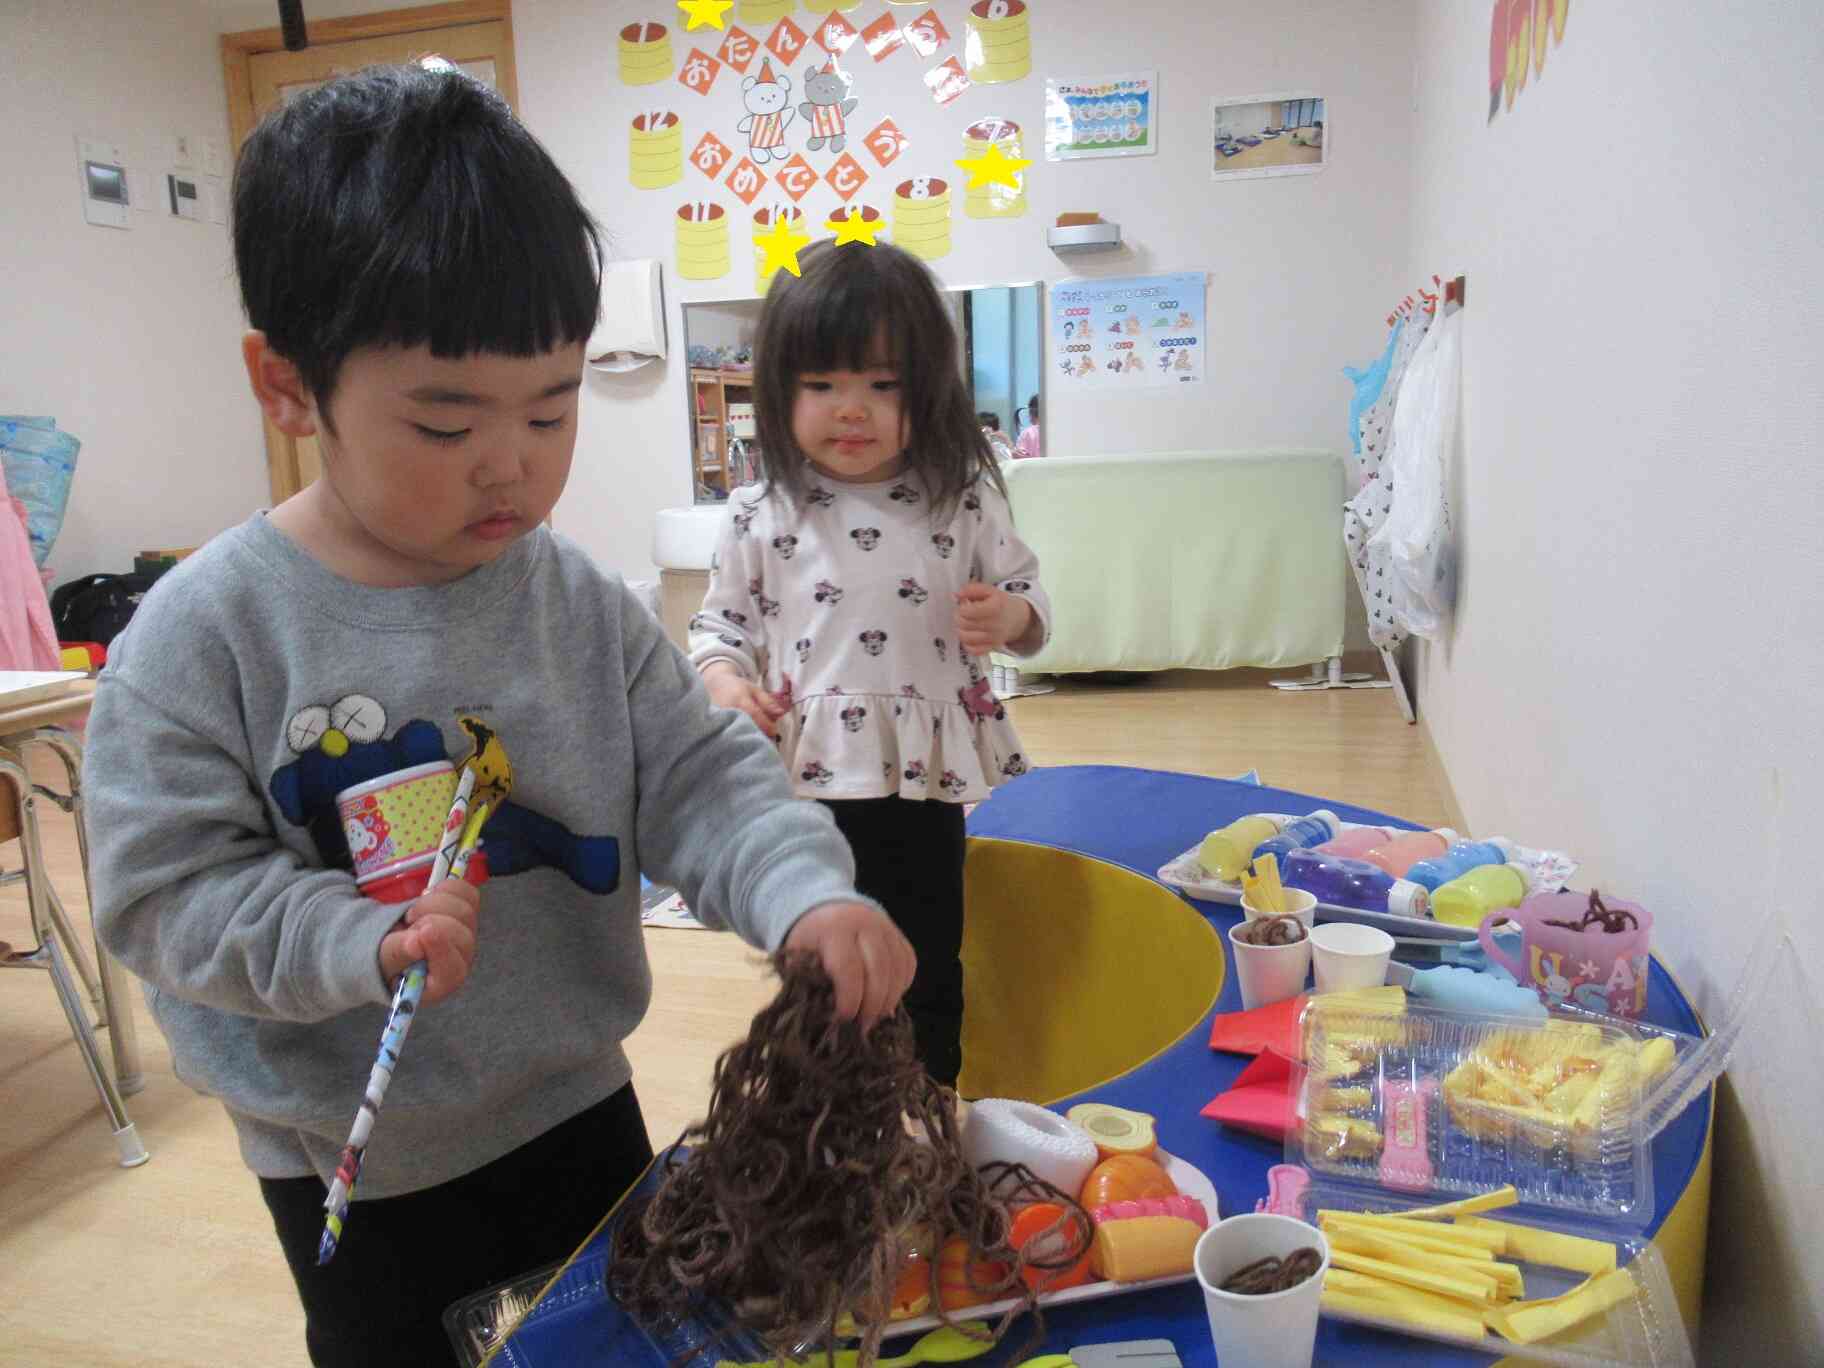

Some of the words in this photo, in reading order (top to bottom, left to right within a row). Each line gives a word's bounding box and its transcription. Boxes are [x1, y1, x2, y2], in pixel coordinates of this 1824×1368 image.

[638, 18, 649, 45] 1
[644, 109, 671, 132] 12
[697, 128, 899, 194] おめでとう
[910, 175, 930, 200] 8
[691, 200, 710, 223] 11
